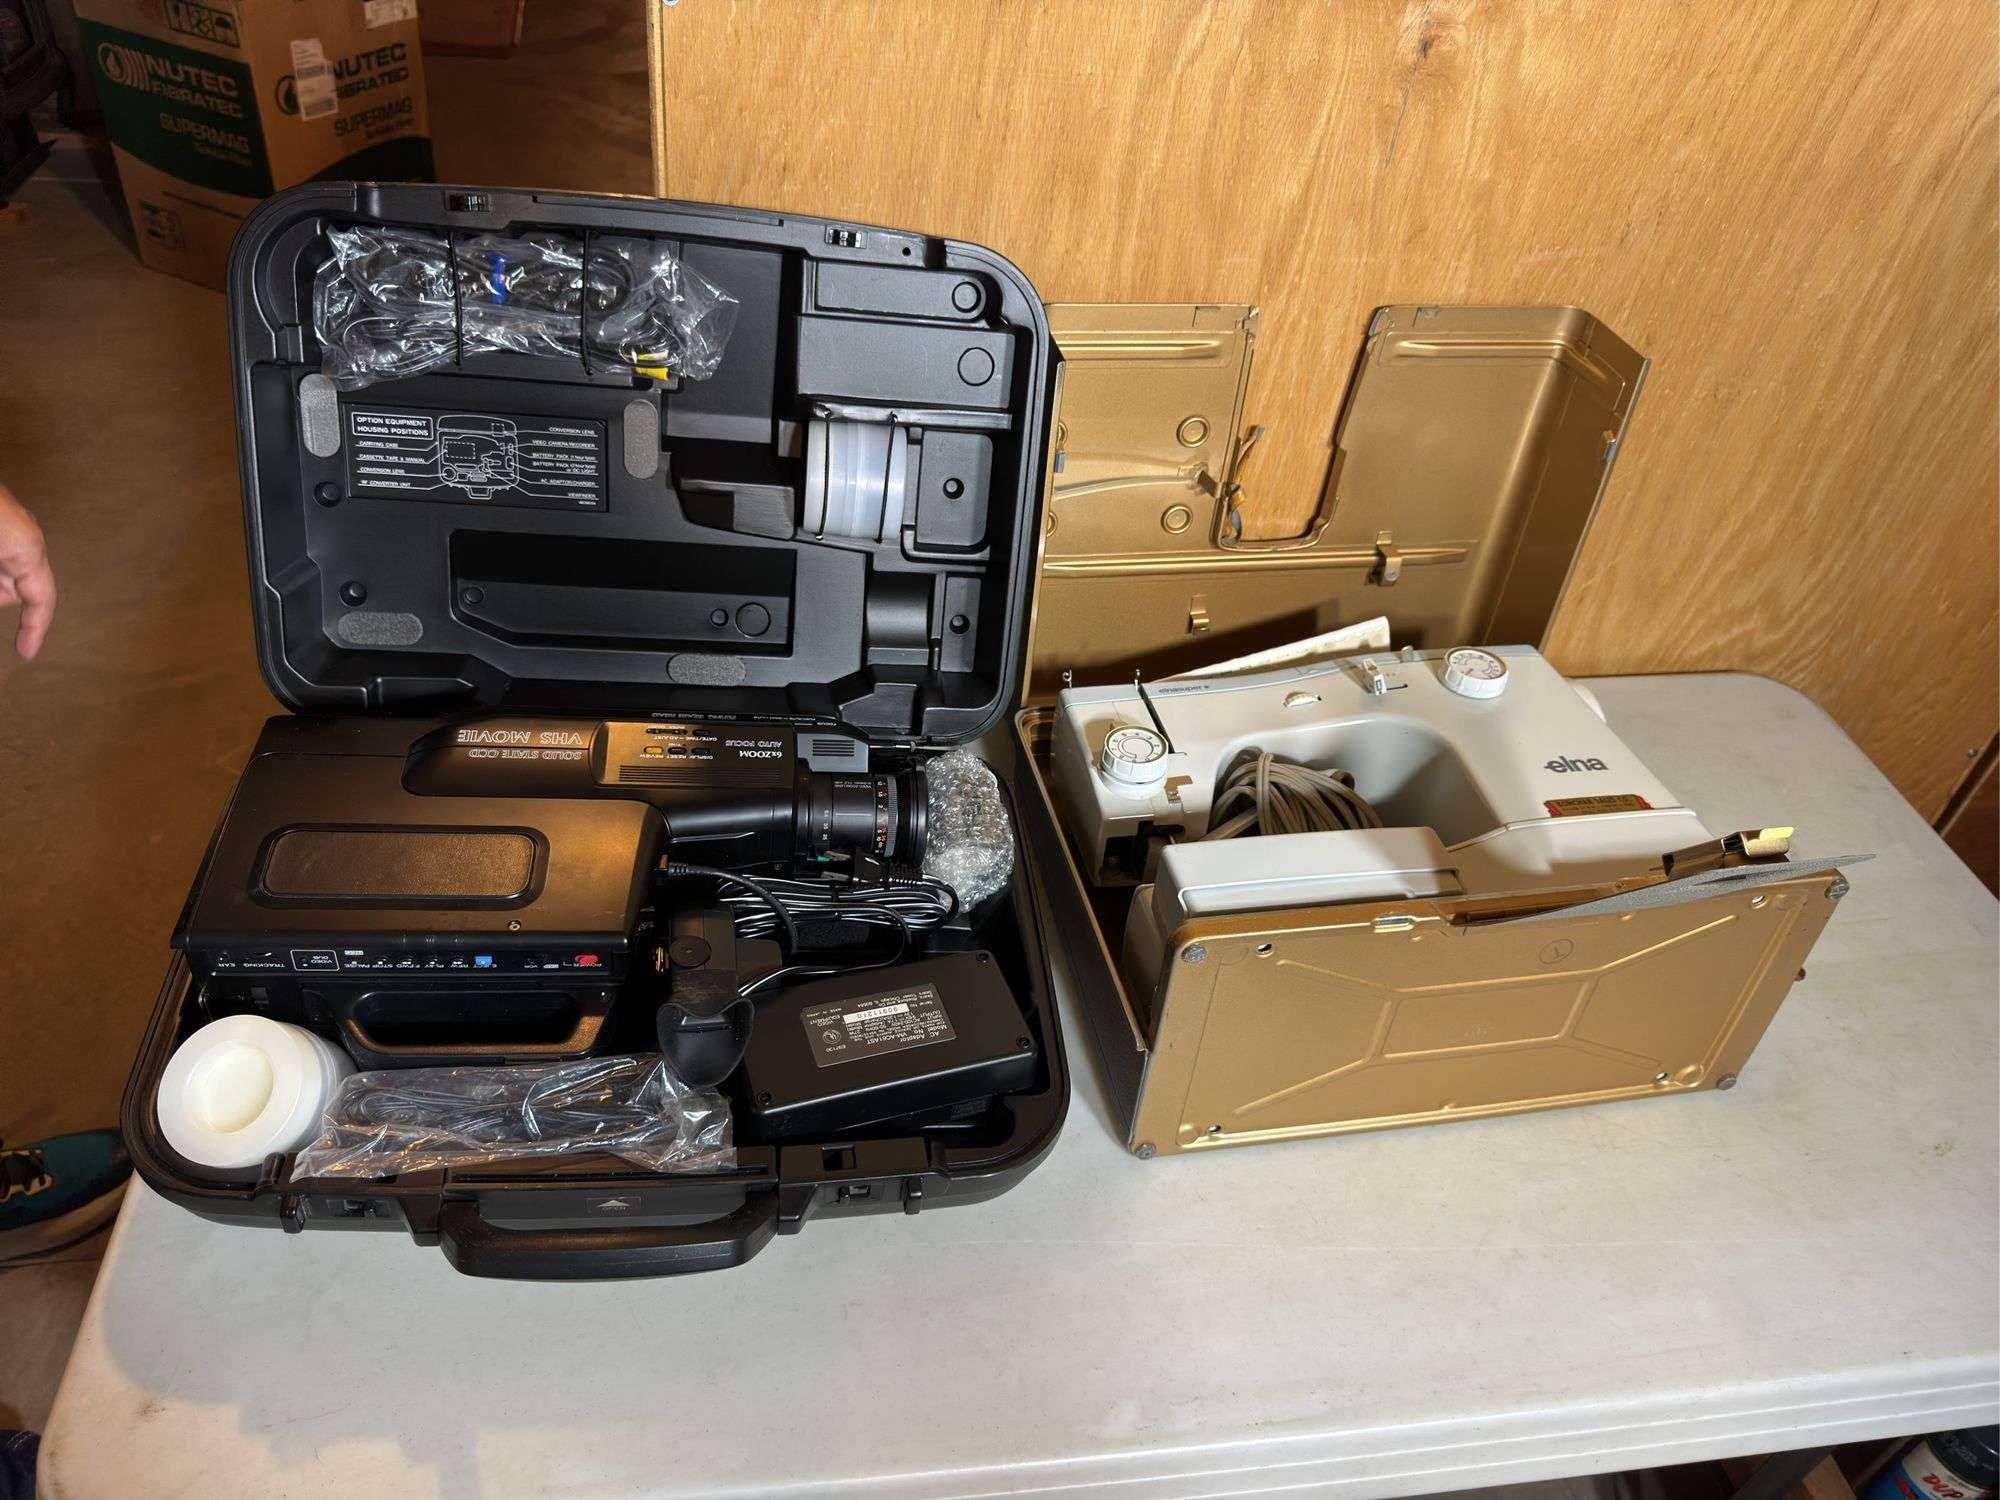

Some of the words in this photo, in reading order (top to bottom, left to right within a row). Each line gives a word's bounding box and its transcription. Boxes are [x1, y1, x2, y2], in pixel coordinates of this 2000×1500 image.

[146, 54, 239, 97] NUTEC
[385, 418, 427, 426] EQUIPMENT
[391, 428, 428, 436] POSITIONS
[458, 729, 531, 744] MOVIE
[540, 731, 583, 745] VHS
[468, 749, 499, 758] CCD
[501, 750, 539, 760] STATE
[542, 750, 582, 760] SOLID
[739, 750, 782, 759] 6xZOOM
[1544, 755, 1608, 773] elna
